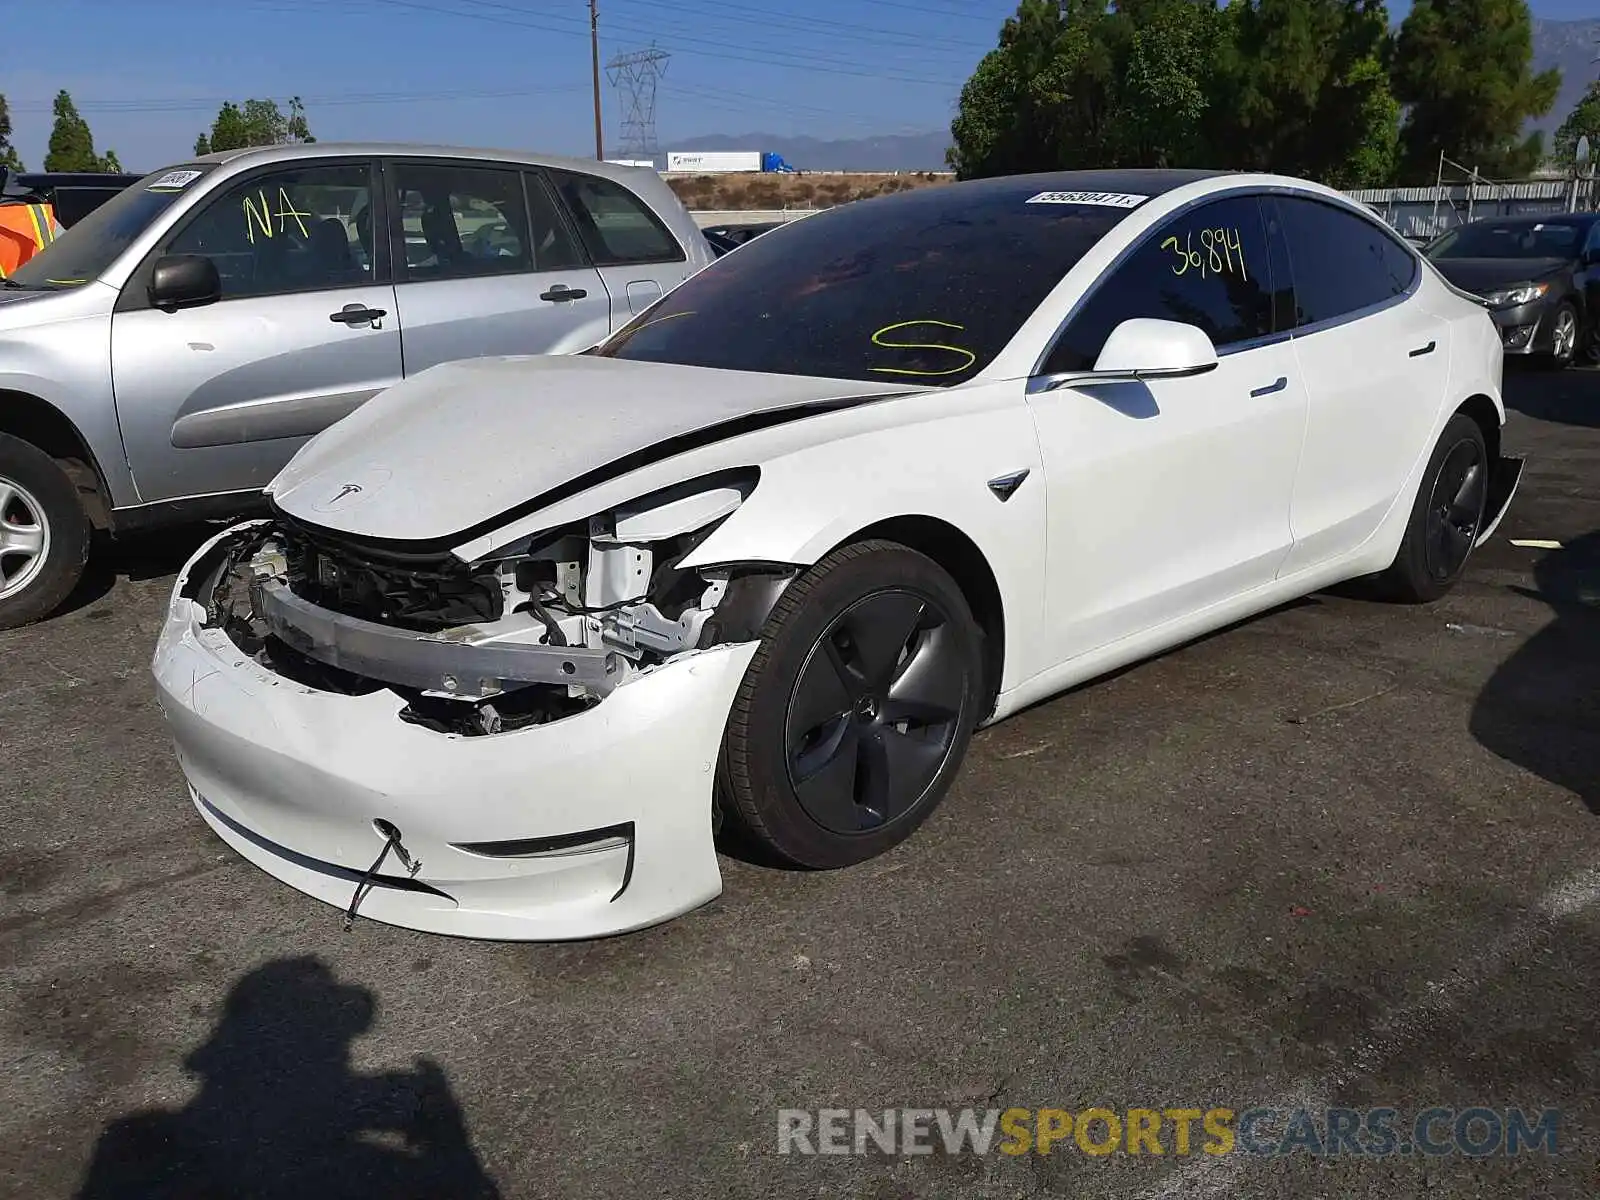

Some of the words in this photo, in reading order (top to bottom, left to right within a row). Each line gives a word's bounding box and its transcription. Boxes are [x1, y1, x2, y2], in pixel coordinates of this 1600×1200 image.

[243, 187, 311, 244] NA
[1160, 227, 1247, 281] 36,894
[866, 320, 976, 376] S
